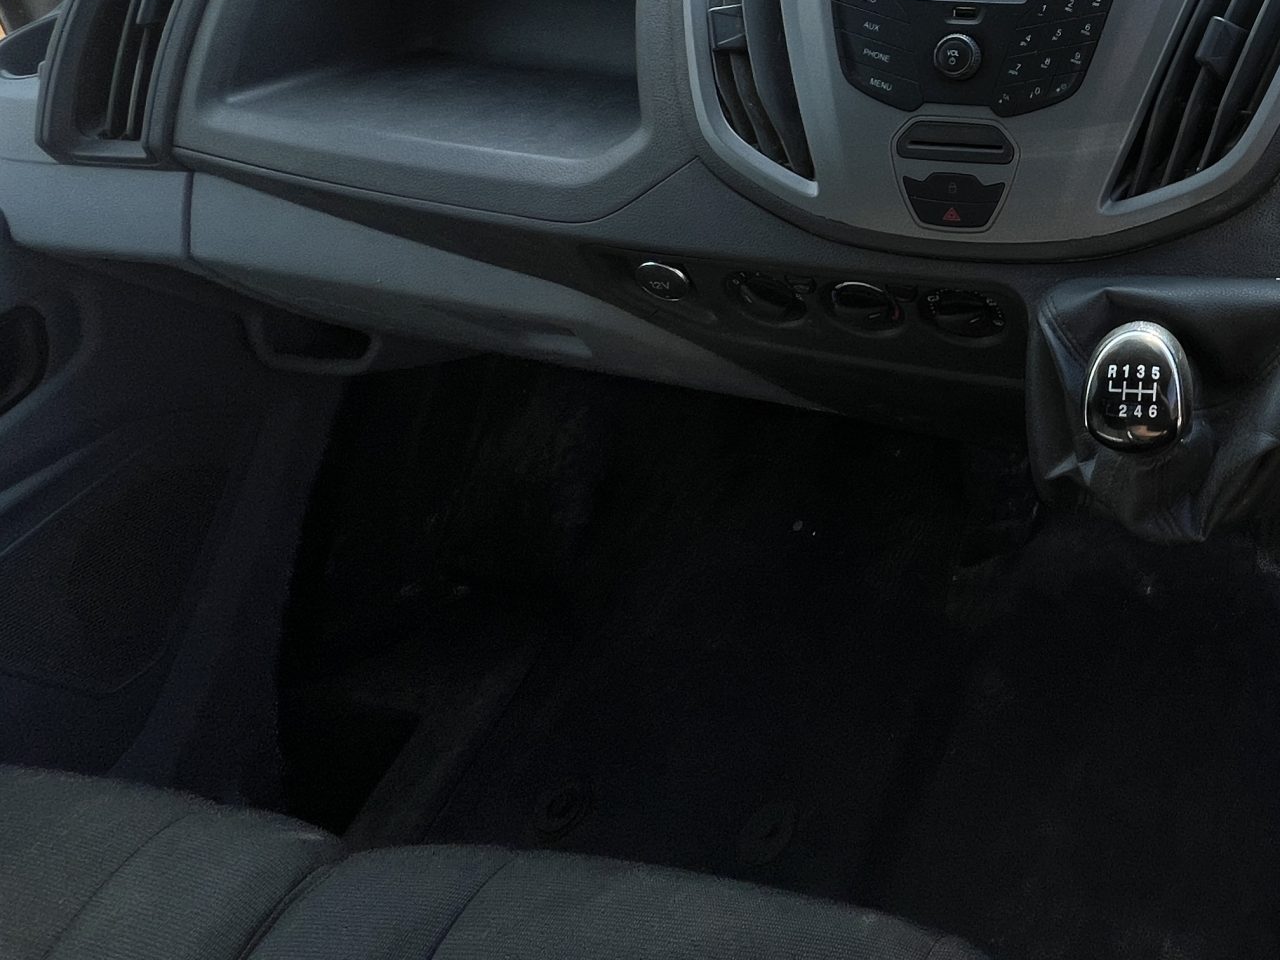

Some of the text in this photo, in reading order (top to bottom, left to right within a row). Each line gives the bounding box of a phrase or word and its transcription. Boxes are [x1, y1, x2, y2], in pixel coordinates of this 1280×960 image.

[863, 21, 880, 32] AUX
[862, 48, 890, 63] PHONE
[946, 49, 960, 57] VOL
[869, 77, 893, 91] MENU
[649, 281, 670, 290] 12V
[1107, 364, 1160, 380] R 1 3 5
[1118, 404, 1158, 418] 2 4 6
